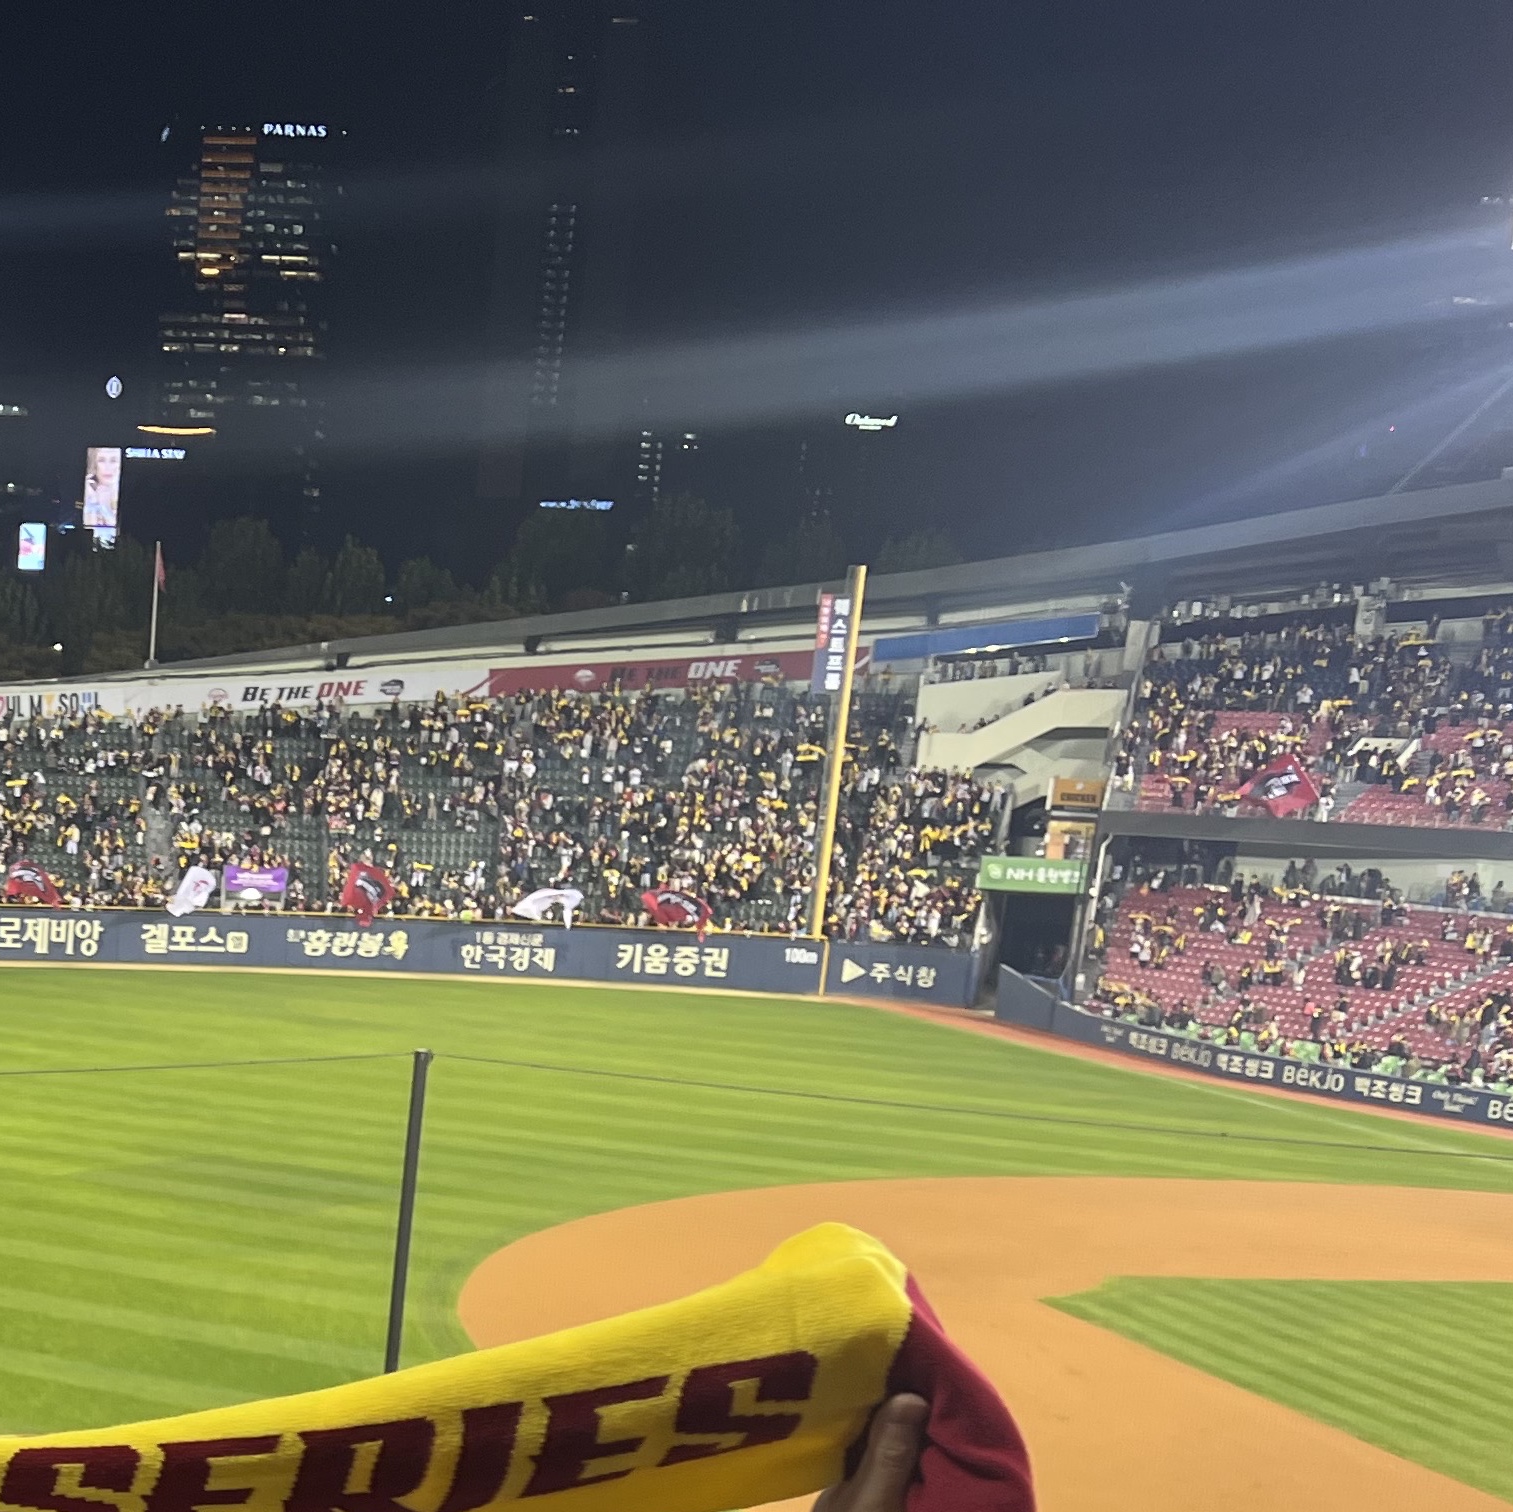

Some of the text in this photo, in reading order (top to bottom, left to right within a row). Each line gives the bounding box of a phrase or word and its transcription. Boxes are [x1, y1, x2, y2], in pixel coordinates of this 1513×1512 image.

[263, 123, 327, 138] PARNAS
[688, 659, 742, 679] ONE
[242, 686, 272, 702] BE
[276, 685, 314, 700] THE
[317, 680, 368, 698] ONE
[1006, 868, 1034, 881] NH
[461, 943, 557, 972] 한국경제
[616, 943, 731, 977] 키움증권
[784, 948, 819, 964] 100m
